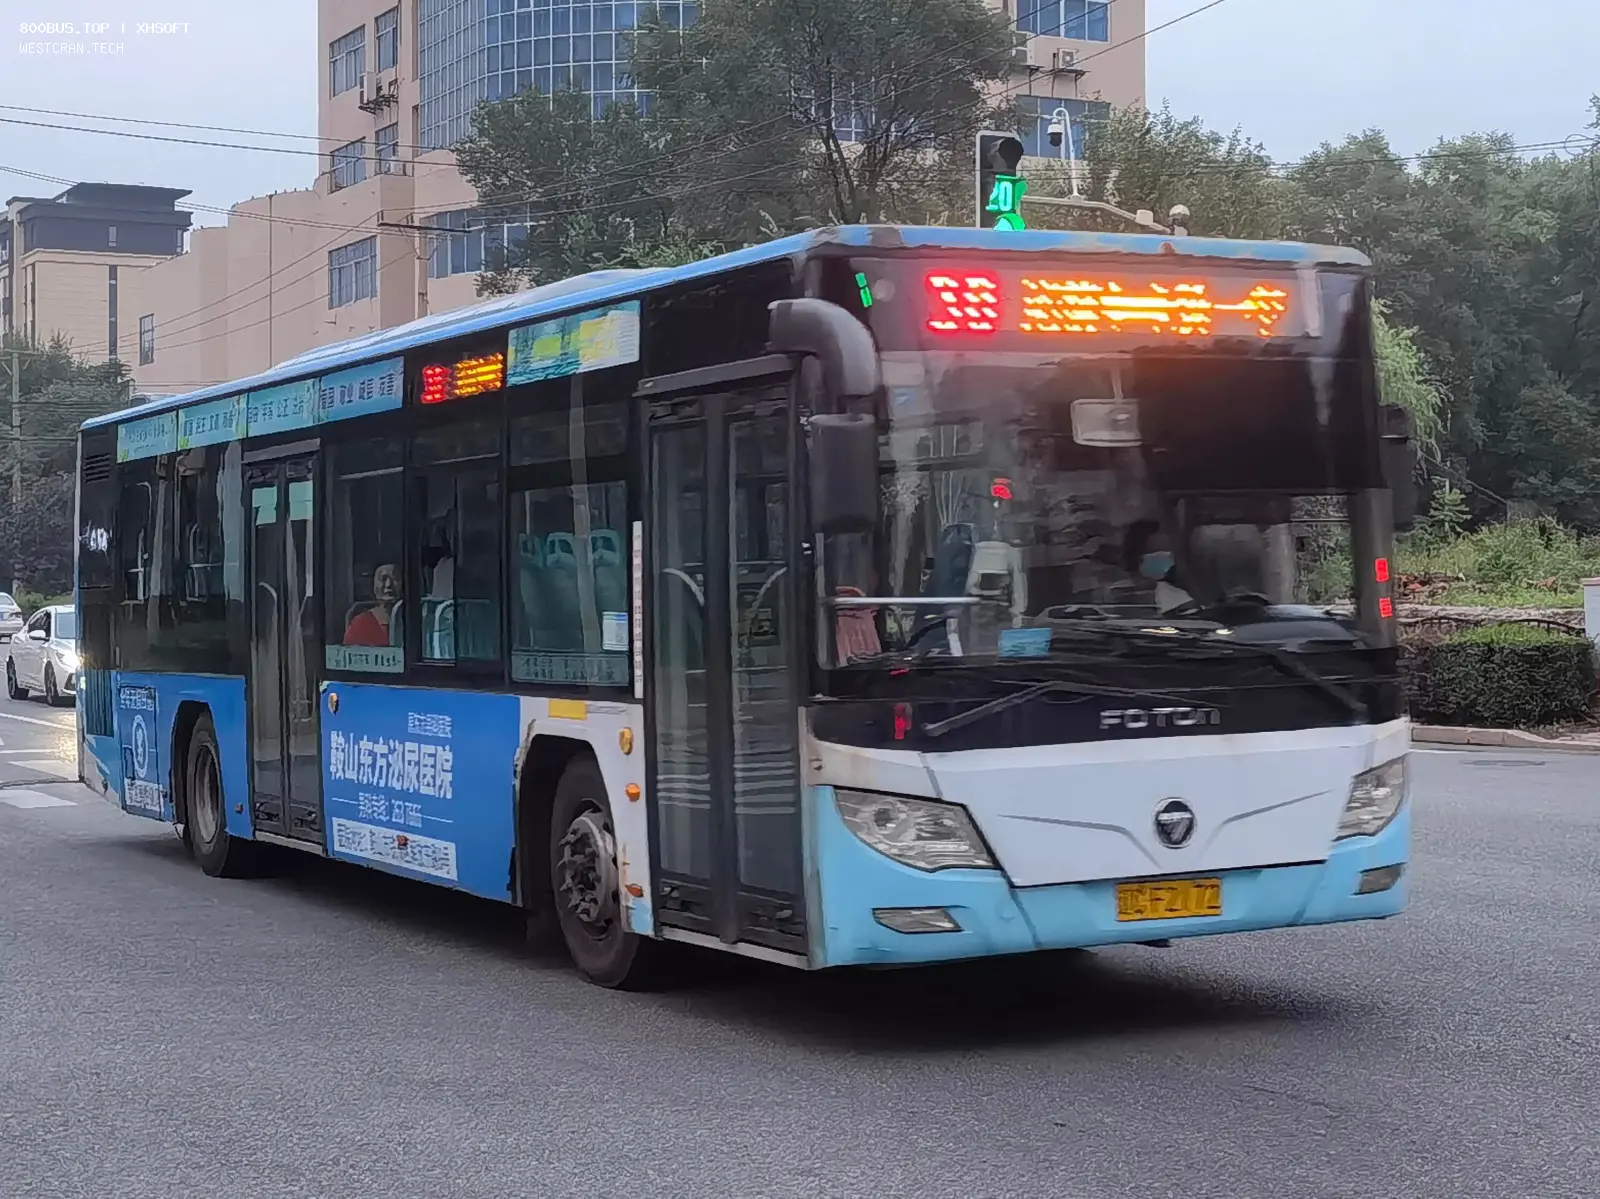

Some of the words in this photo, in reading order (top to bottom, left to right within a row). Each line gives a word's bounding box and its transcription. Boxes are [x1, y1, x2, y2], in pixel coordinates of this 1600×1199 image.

[1099, 706, 1221, 729] FOTON
[329, 730, 453, 799] 鞍山东方泌尿医院
